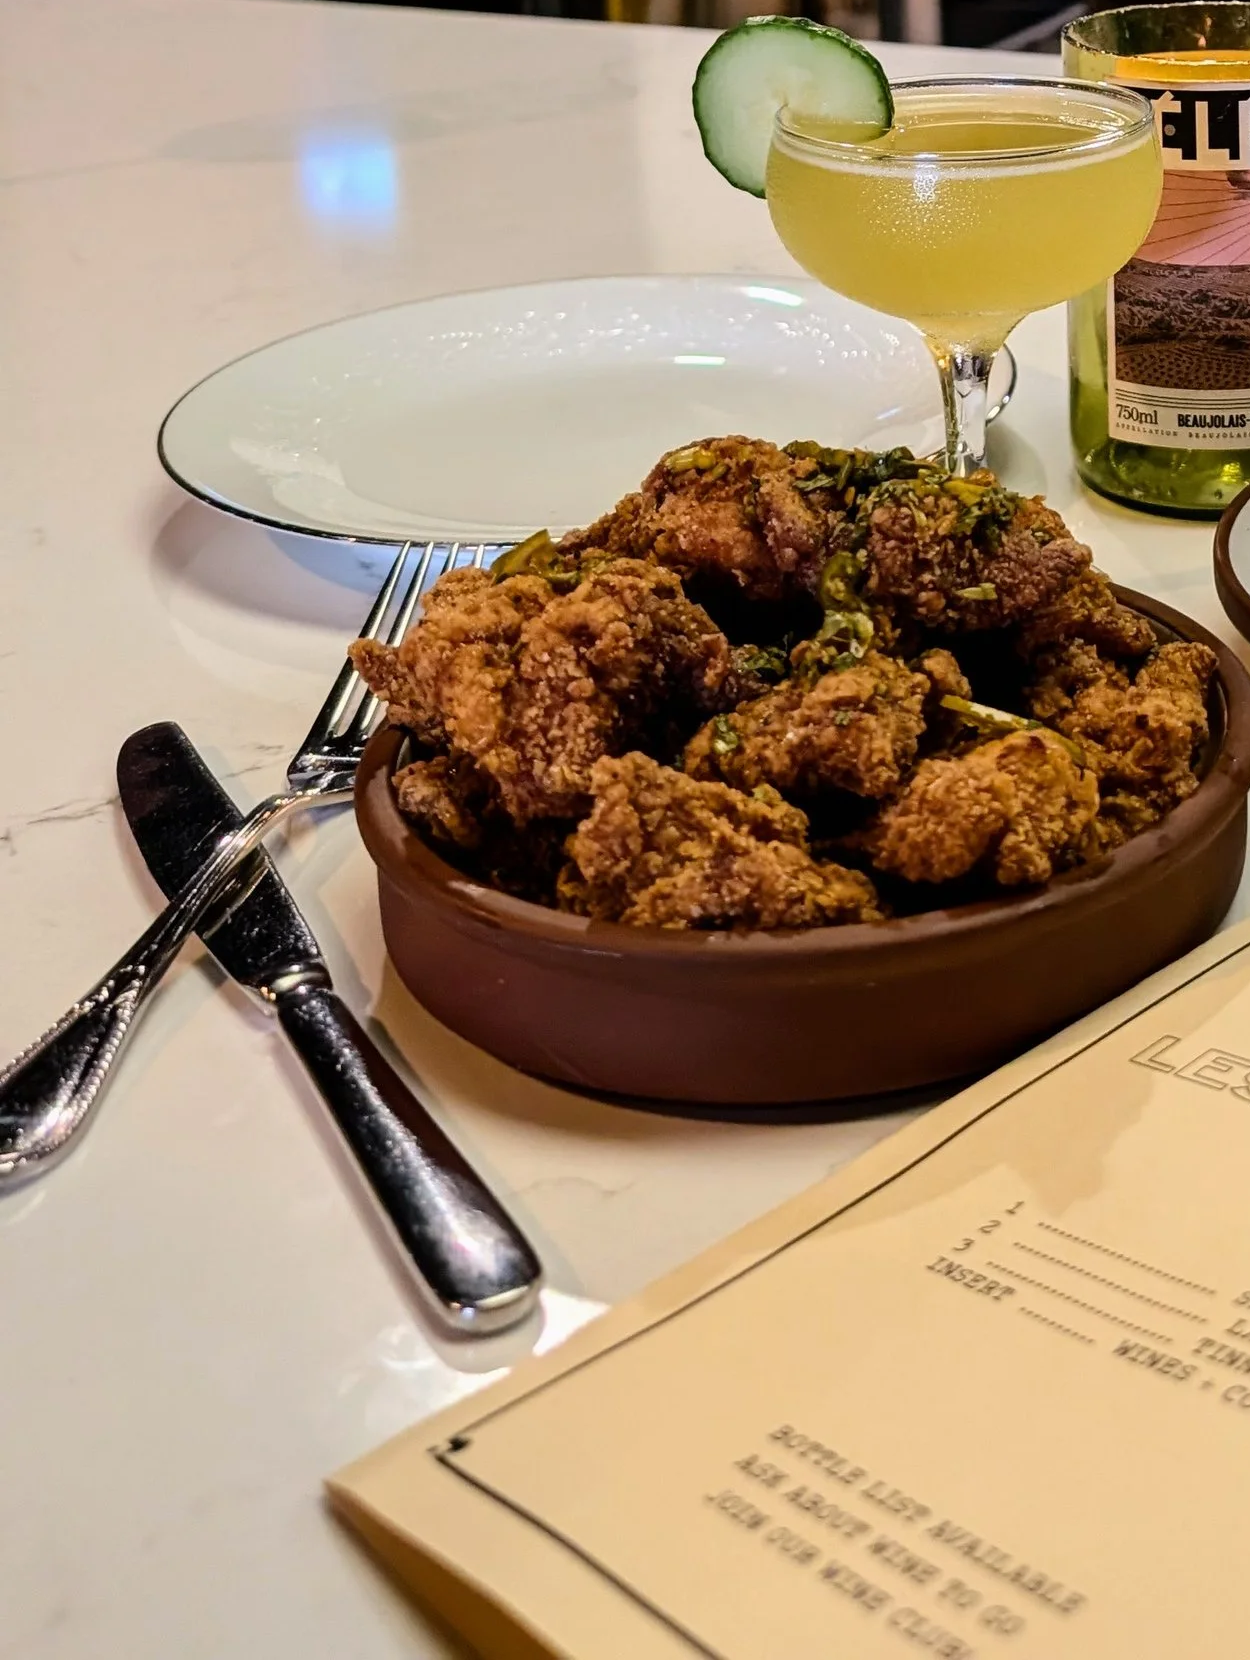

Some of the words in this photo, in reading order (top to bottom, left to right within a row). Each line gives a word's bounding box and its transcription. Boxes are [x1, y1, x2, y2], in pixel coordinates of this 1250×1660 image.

[1116, 404, 1158, 425] 750ml
[978, 1219, 1001, 1234] 2
[1005, 1200, 1025, 1216] 1
[953, 1238, 975, 1252] 3
[925, 1255, 1018, 1302] INSERT
[1112, 1339, 1199, 1382] WINES
[704, 1490, 771, 1531] JOIN
[764, 1526, 822, 1565] OUR
[818, 1560, 895, 1612] WINE
[733, 1453, 790, 1488] ASK
[783, 1485, 873, 1539] ABOUT
[867, 1534, 943, 1585] WINE
[937, 1577, 984, 1608] TO
[977, 1604, 1027, 1635] GO
[768, 1424, 869, 1485] BOTTLE
[861, 1479, 932, 1521] LIST
[924, 1519, 1089, 1614] AVAILABLE
